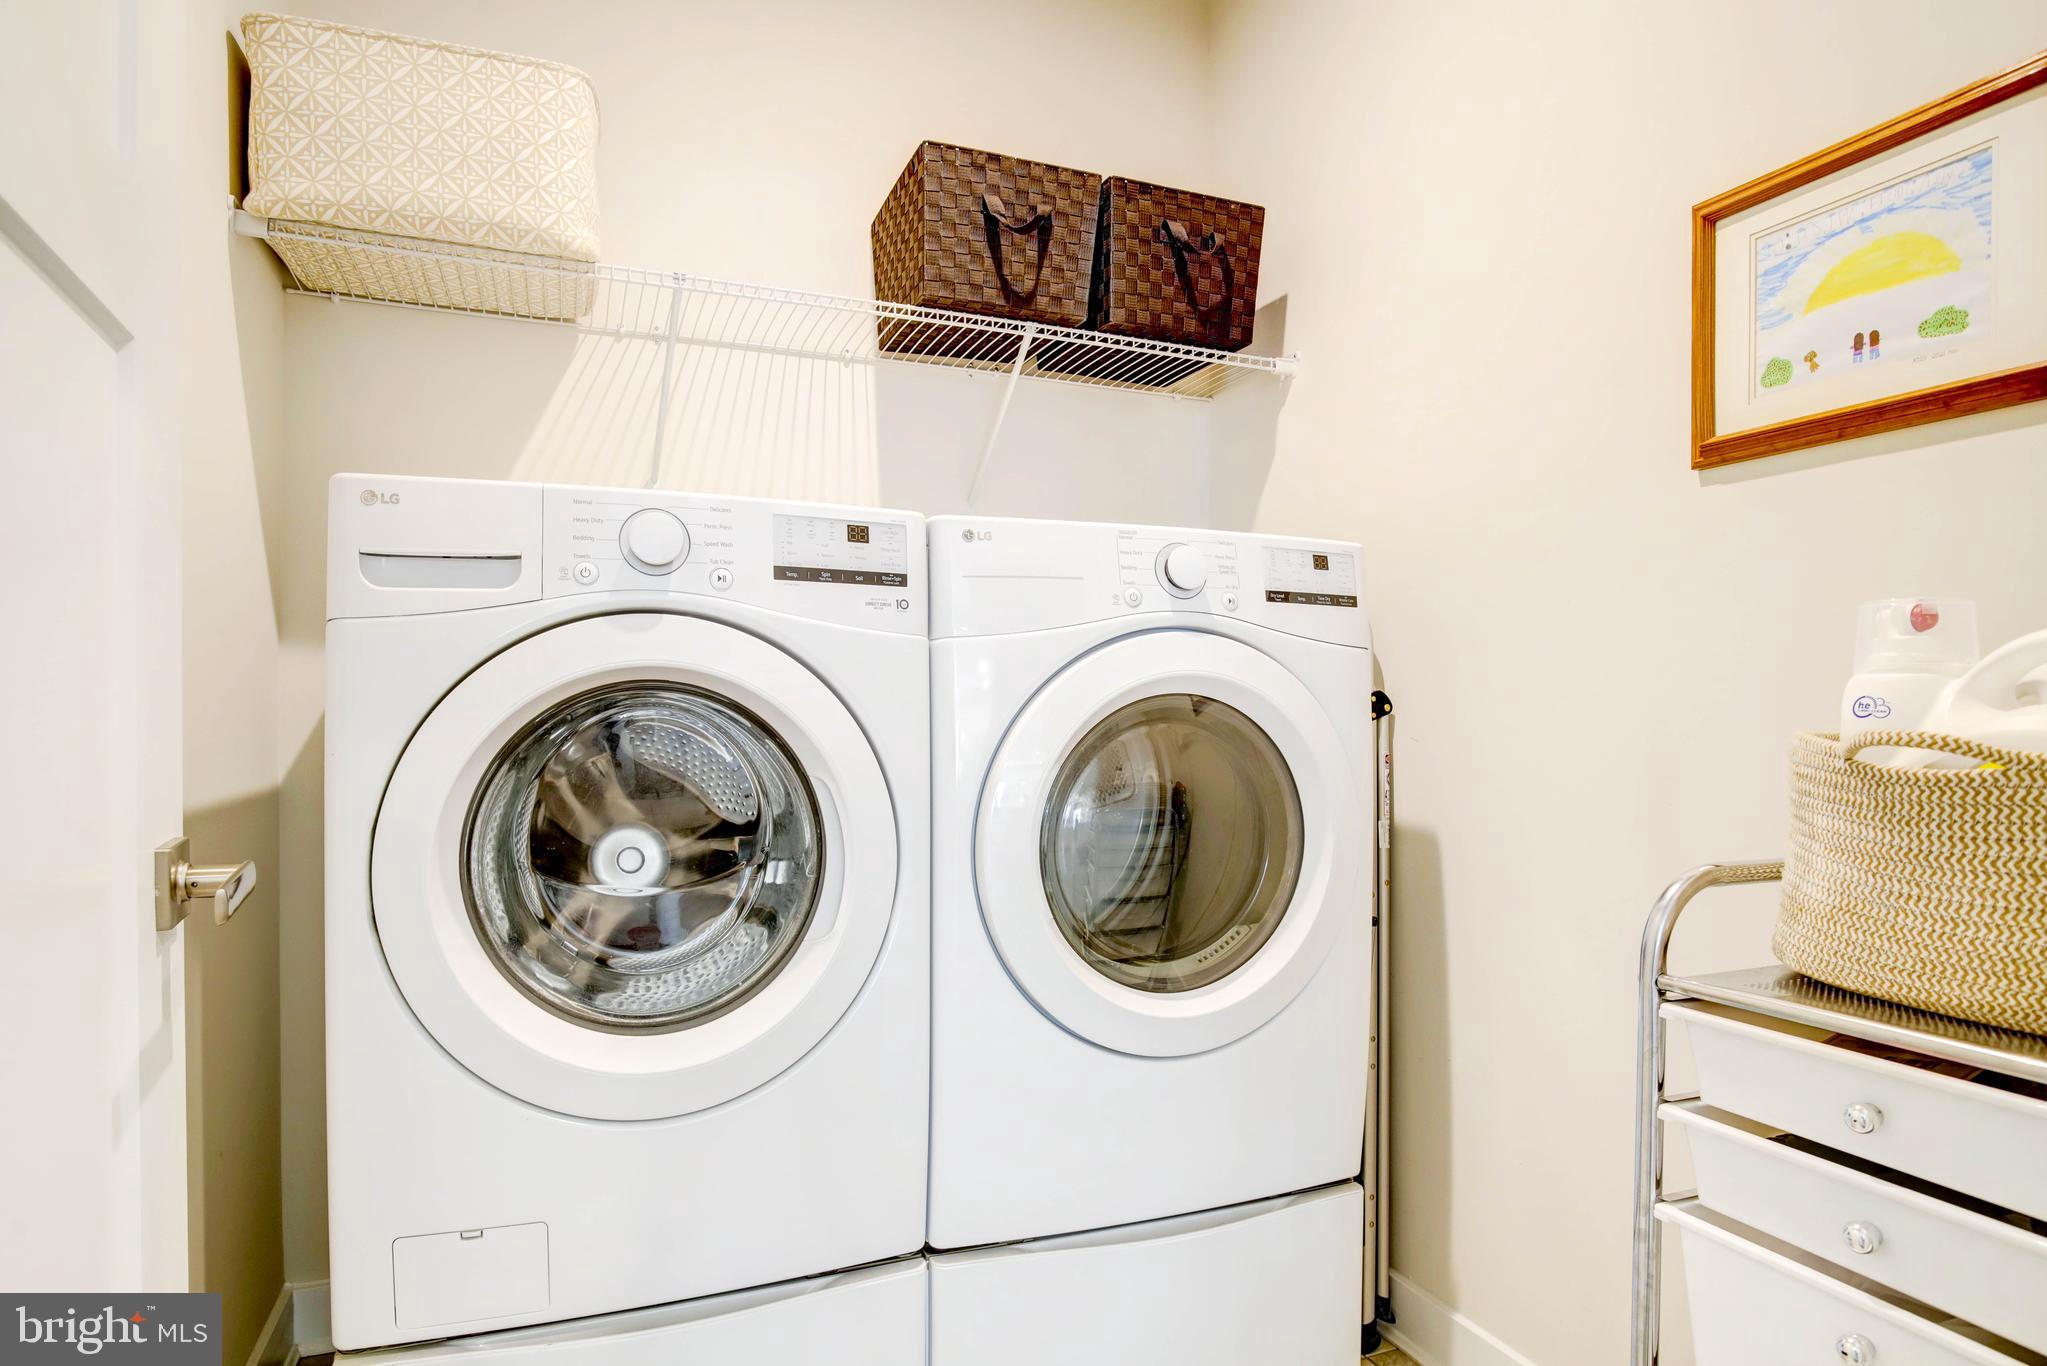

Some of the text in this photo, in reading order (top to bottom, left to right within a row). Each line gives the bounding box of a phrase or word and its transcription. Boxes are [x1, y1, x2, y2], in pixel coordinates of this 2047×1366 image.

[381, 493, 400, 505] LG
[590, 517, 604, 525] Duty
[976, 531, 993, 541] LG
[896, 599, 909, 610] 10
[1857, 701, 1871, 710] he
